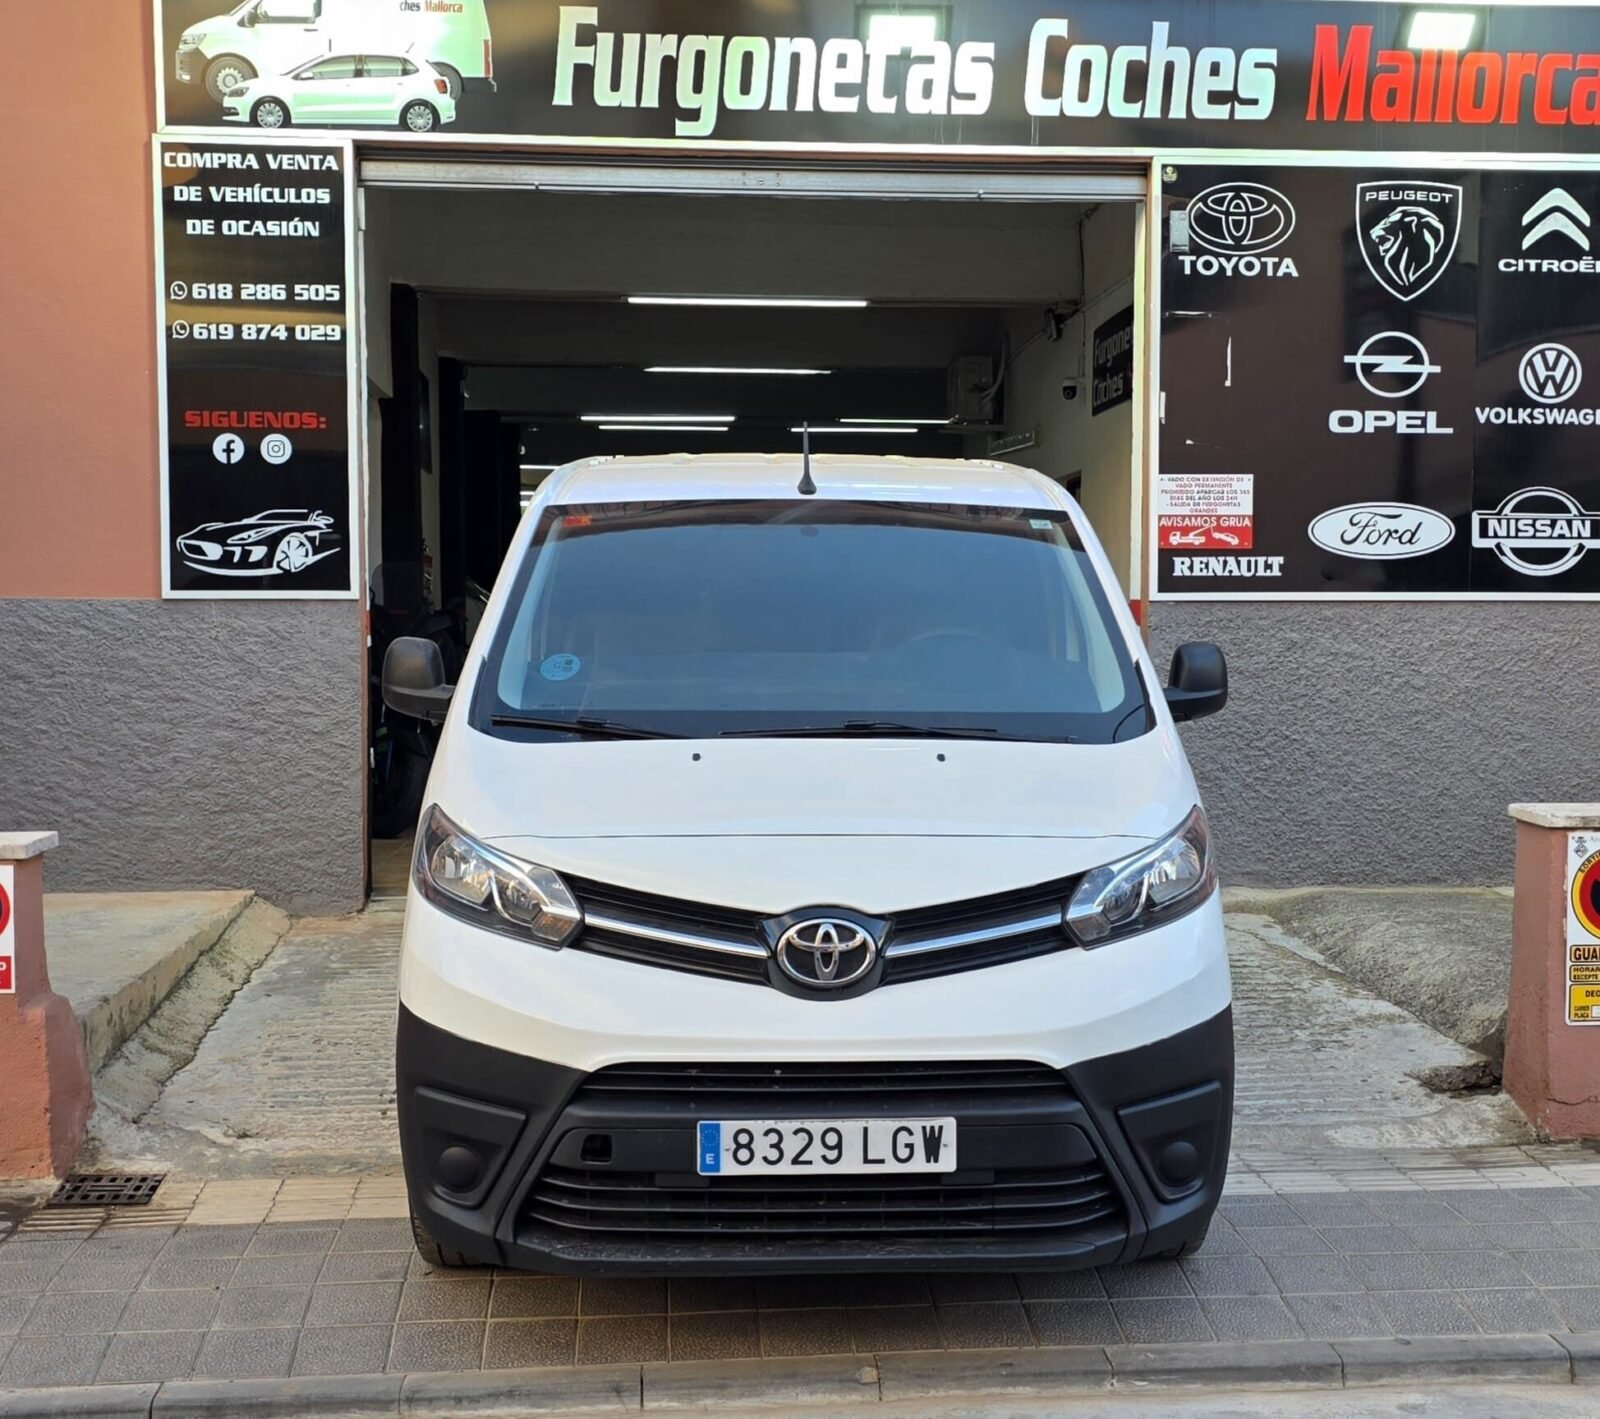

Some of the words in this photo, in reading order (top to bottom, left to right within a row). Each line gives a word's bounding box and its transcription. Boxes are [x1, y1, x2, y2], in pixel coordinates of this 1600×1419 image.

[552, 6, 995, 136] Furgonetas
[1024, 18, 1278, 120] Coches
[1306, 24, 1600, 125] Mallorca
[164, 151, 259, 170] COMPRA
[265, 153, 339, 171] VENTA
[173, 186, 202, 202] DE
[209, 183, 331, 204] VEHÍCULOS
[1365, 190, 1453, 204] PEUGEOT
[186, 219, 215, 235] DE
[222, 217, 320, 237] OCASIÓN
[1178, 255, 1299, 277] TOYOTA
[192, 283, 233, 300] 618
[241, 284, 286, 300] 286
[294, 284, 340, 301] 505
[193, 323, 234, 340] 619
[241, 324, 288, 341] 874
[295, 325, 341, 341] 029
[1093, 372, 1124, 407] Coches
[184, 410, 327, 429] SIGUENOS:
[1328, 409, 1453, 434] OPEL
[1160, 516, 1217, 528] AVISAMOS
[1219, 516, 1252, 528] GRUA
[1340, 511, 1423, 545] Ford
[1488, 518, 1591, 539] NISSAN
[1172, 556, 1285, 577] RENAULT
[1574, 947, 1600, 961] GUA
[705, 1153, 715, 1165] E
[732, 1127, 844, 1166] 8329
[862, 1125, 944, 1164] LGW
